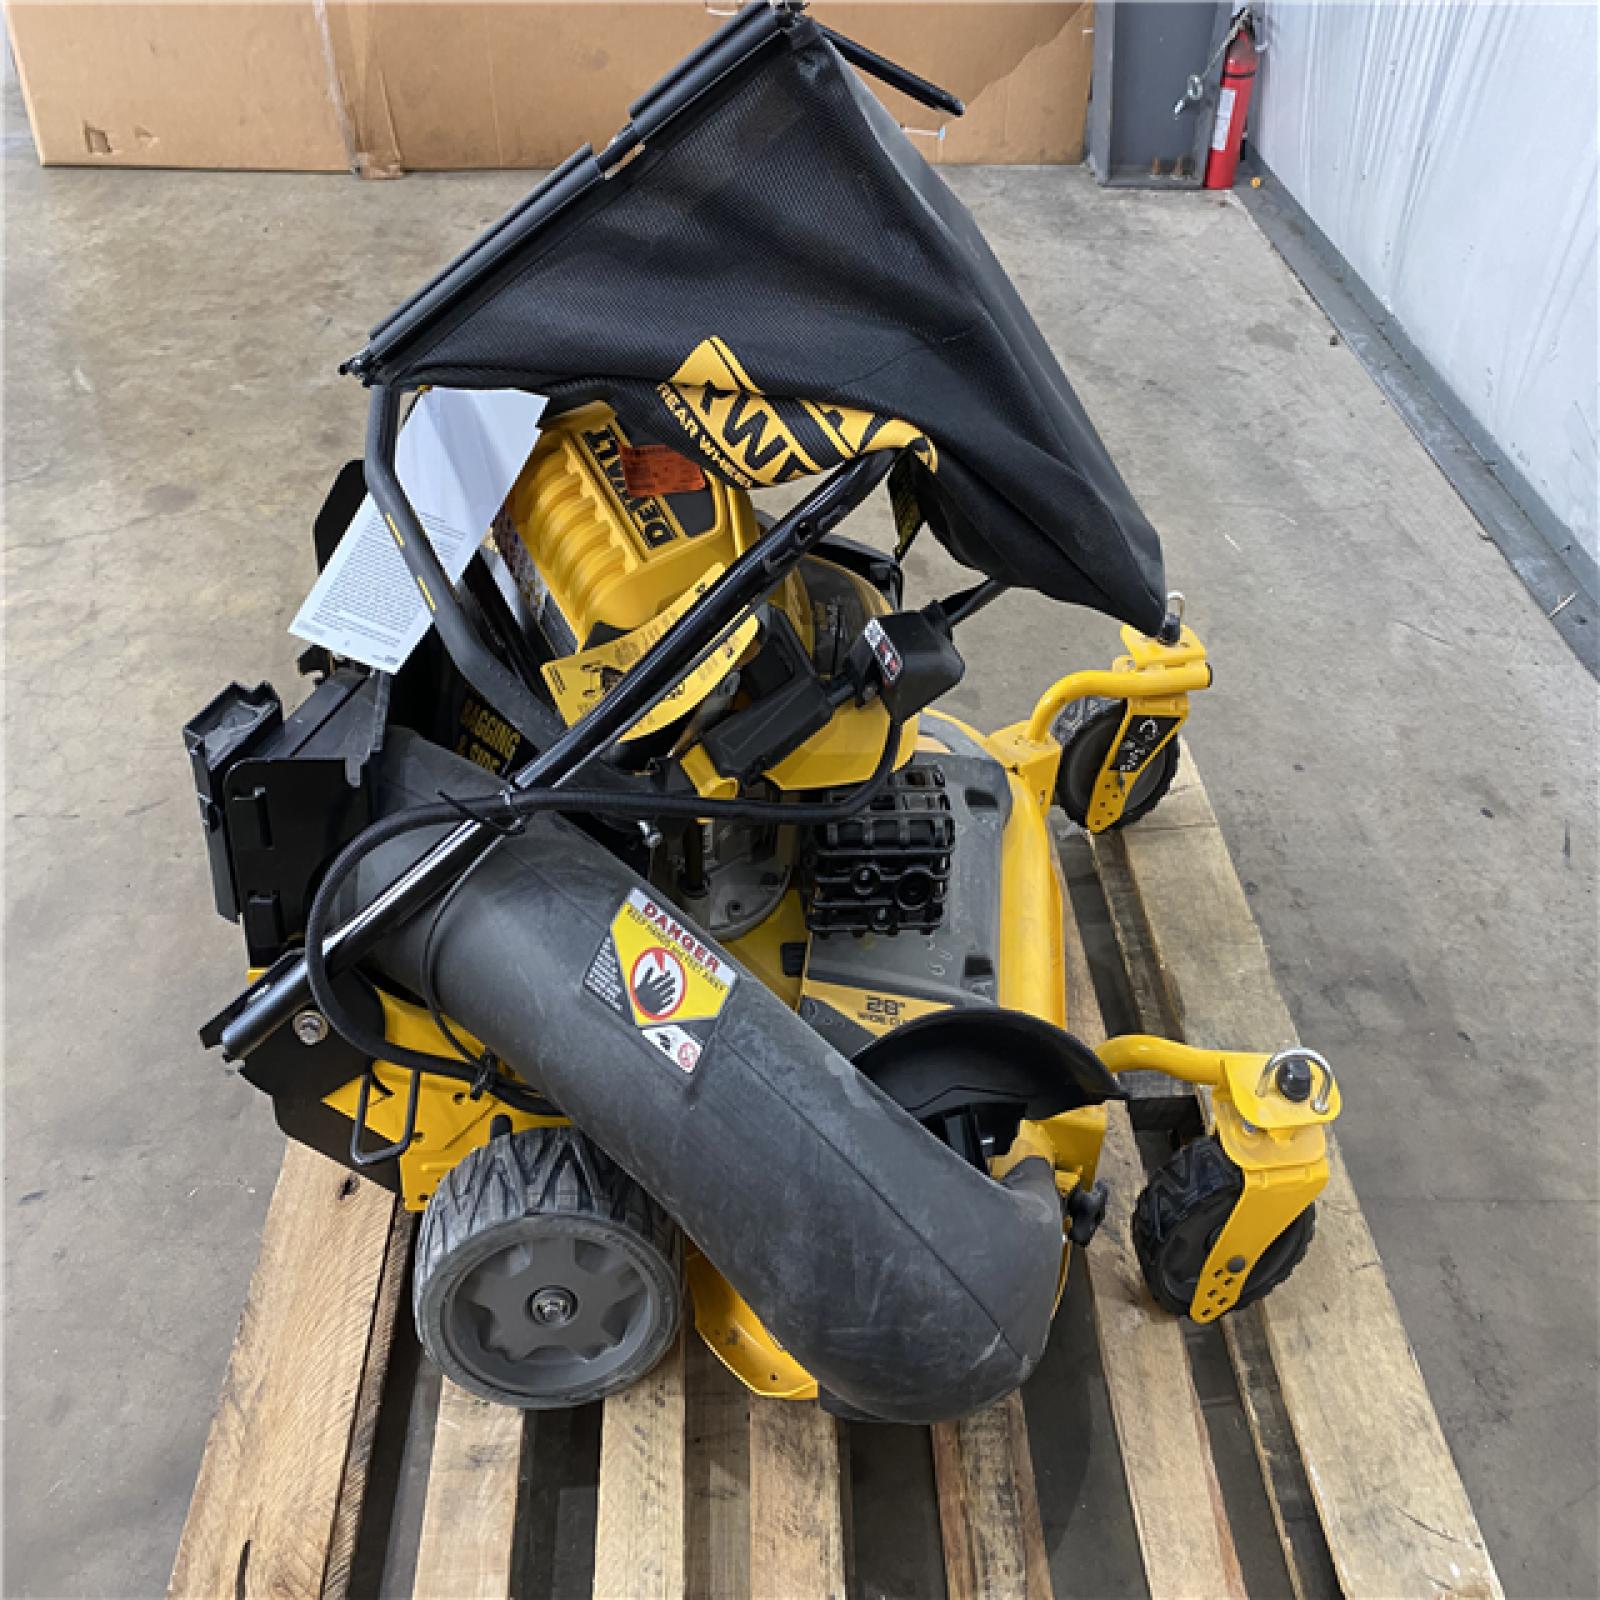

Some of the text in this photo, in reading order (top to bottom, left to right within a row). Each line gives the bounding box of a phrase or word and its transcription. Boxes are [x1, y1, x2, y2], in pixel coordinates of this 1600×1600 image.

[655, 383, 699, 438] REAR
[462, 702, 521, 760] BAGGING
[643, 901, 720, 972] DANGER
